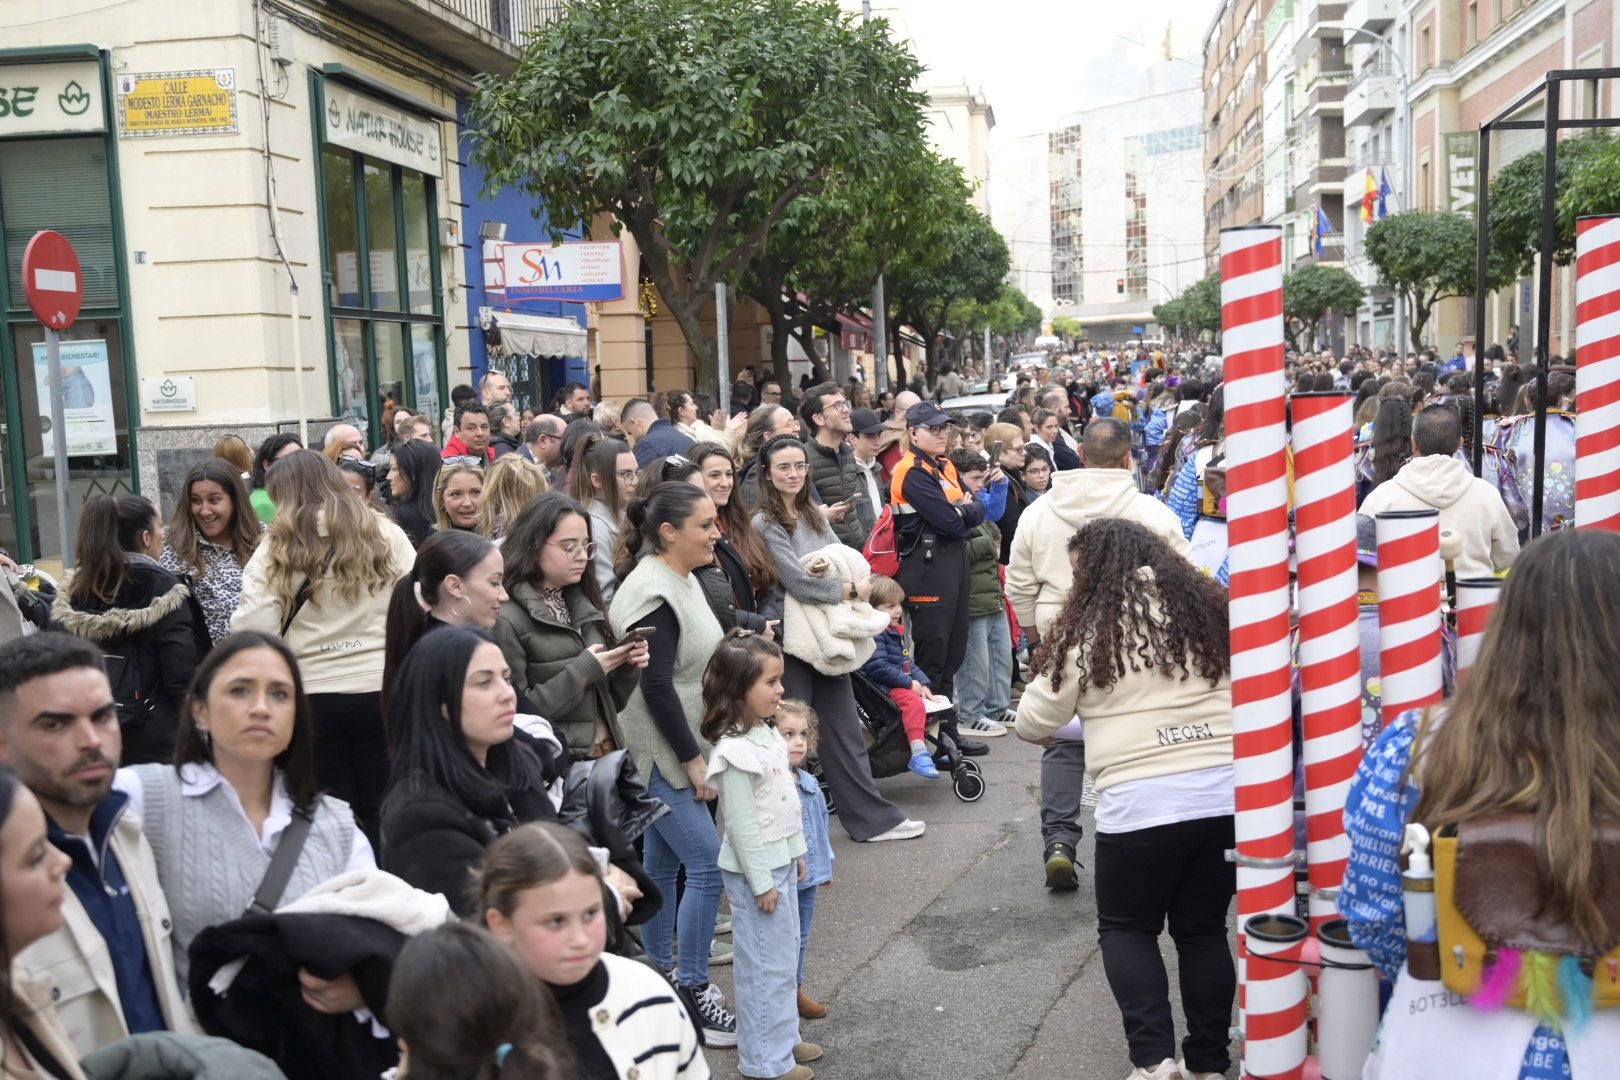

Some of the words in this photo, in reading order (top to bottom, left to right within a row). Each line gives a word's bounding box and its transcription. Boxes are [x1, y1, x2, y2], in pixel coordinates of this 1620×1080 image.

[163, 81, 188, 95] CALLE
[127, 96, 160, 111] MODESTO
[162, 95, 186, 109] LERMA
[187, 93, 227, 107] GARNACHO
[345, 107, 387, 142] NATUR
[389, 121, 424, 156] HOUSE
[510, 285, 584, 295] INMOBILIARIA
[1156, 723, 1214, 746] NEGRI
